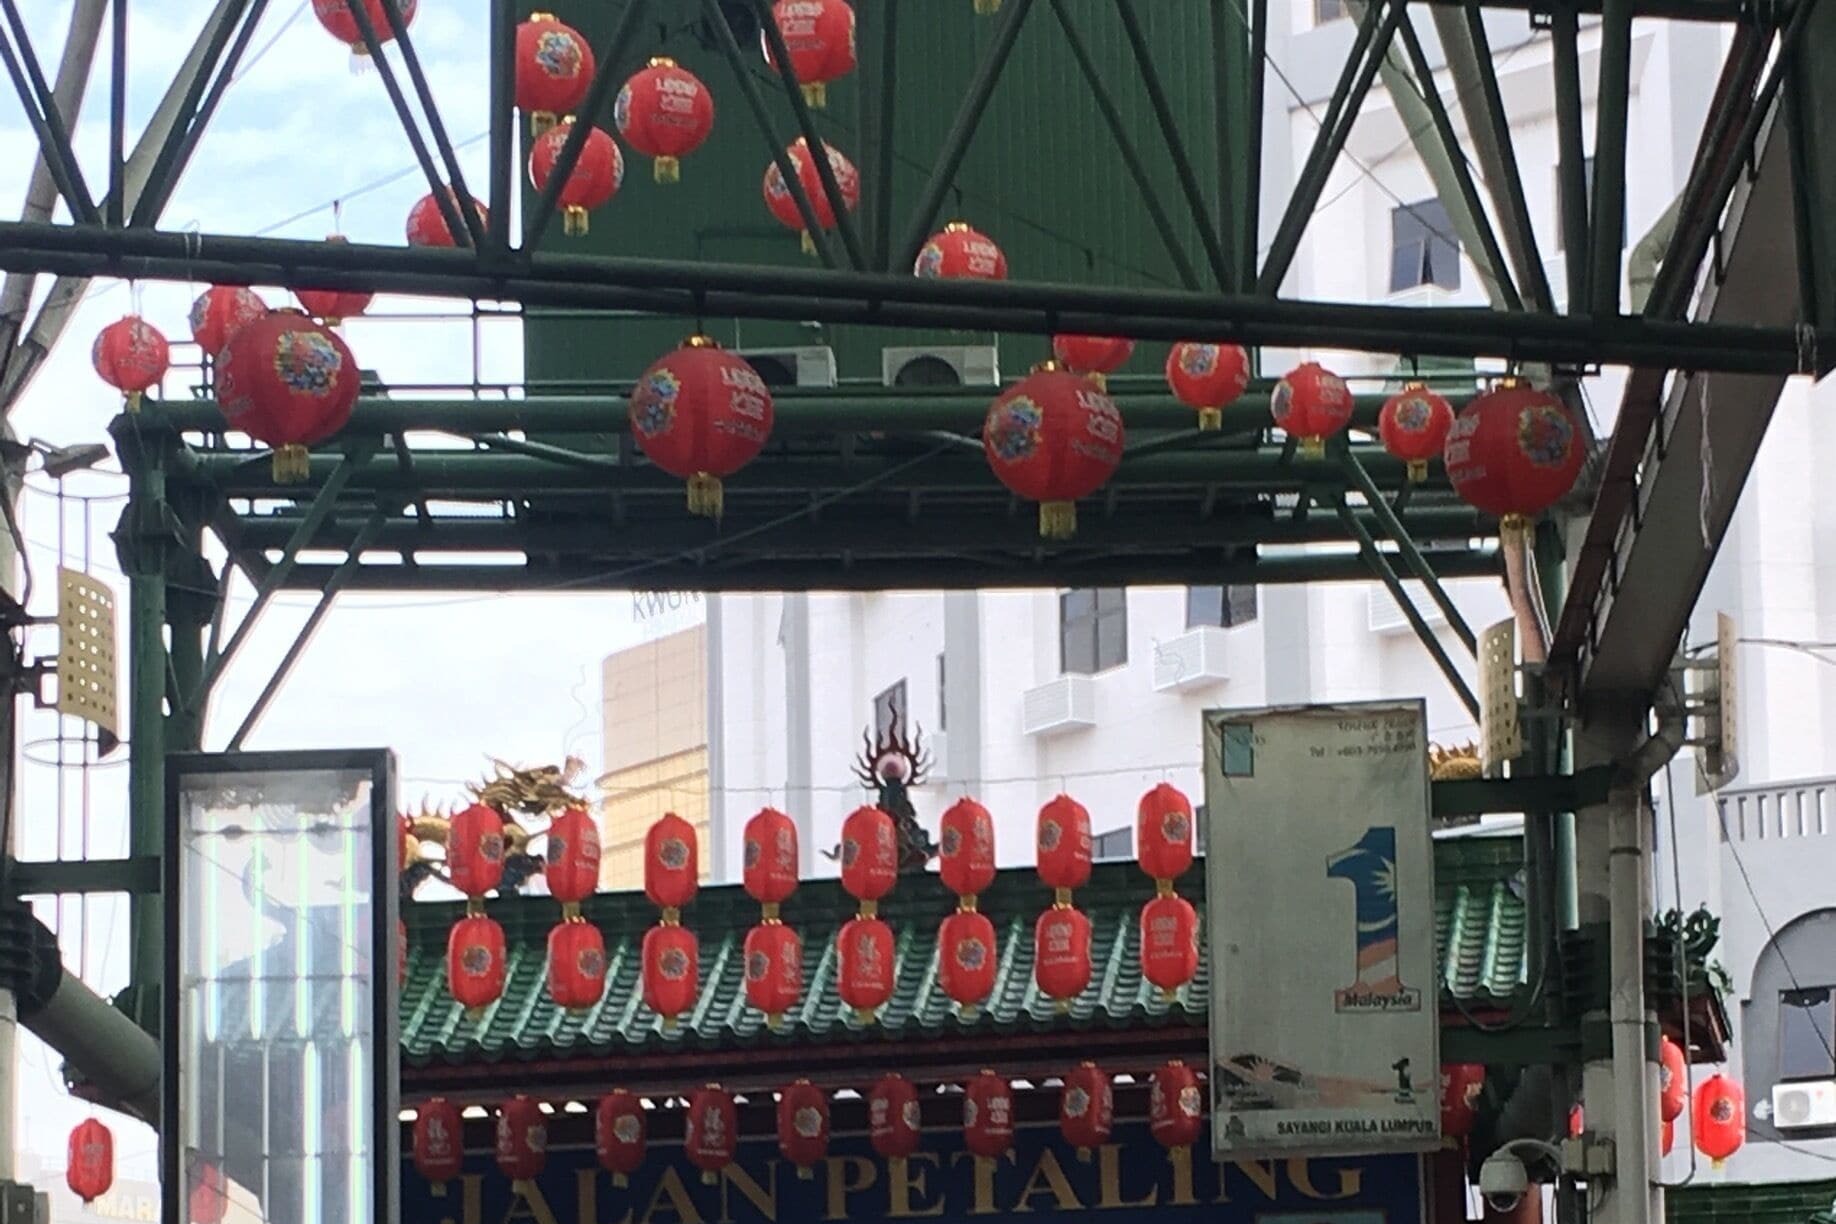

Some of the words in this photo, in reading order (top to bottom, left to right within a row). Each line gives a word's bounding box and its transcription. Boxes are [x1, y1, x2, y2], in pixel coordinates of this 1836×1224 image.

[1343, 989, 1412, 1010] Malaysia
[1277, 1120, 1332, 1135] SAYANGI
[1335, 1119, 1379, 1134] KUALA
[1381, 1118, 1433, 1133] LUMPUR
[821, 1142, 1366, 1221] PETALING
